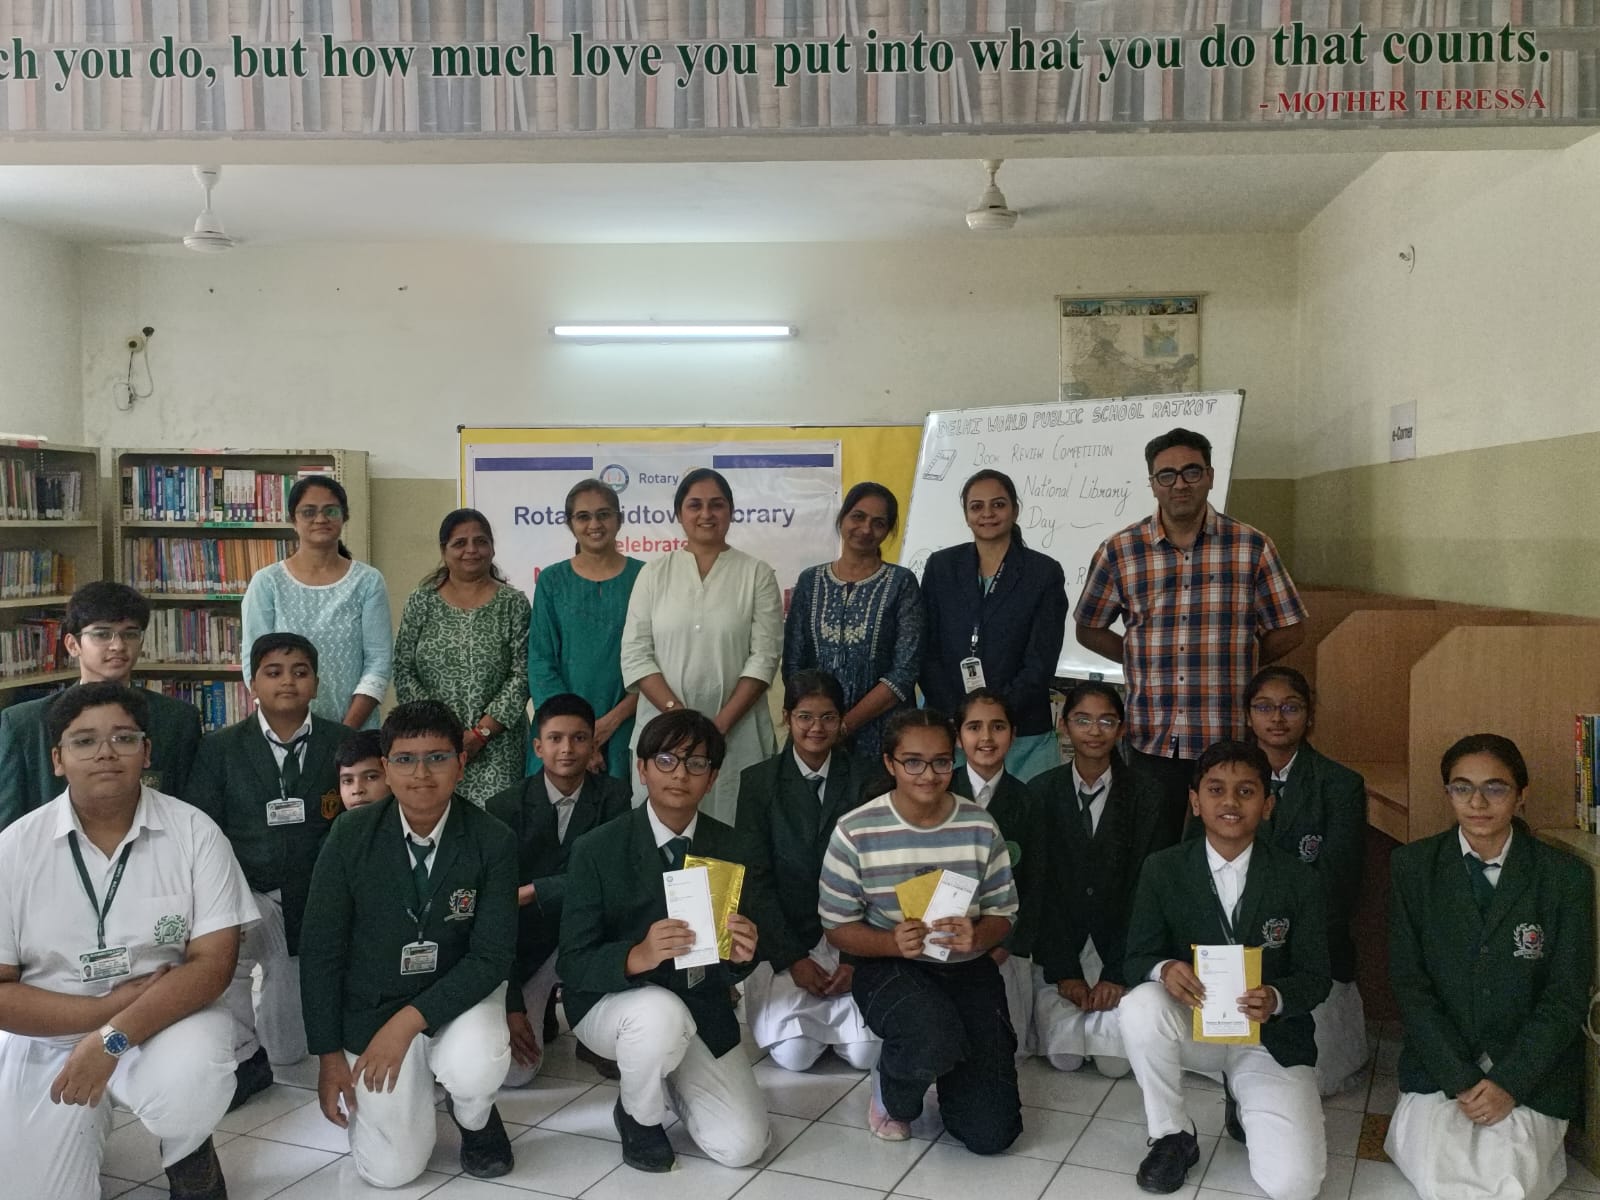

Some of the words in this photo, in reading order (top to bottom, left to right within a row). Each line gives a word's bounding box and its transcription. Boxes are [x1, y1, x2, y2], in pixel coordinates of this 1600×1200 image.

[54, 48, 132, 91] you
[149, 36, 217, 87] do,
[233, 35, 308, 78] but
[323, 34, 414, 78] how
[432, 34, 556, 77] much
[572, 33, 662, 76] love
[677, 43, 757, 88] you
[774, 35, 851, 87] put
[866, 29, 954, 73] into
[970, 27, 1085, 72] what
[1098, 36, 1181, 82] you
[1200, 24, 1256, 68] do
[1273, 22, 1368, 66] that
[1383, 21, 1550, 65] counts.
[1276, 90, 1407, 114] MOTHER
[1415, 88, 1546, 111] TERESSA
[1032, 407, 1085, 429] PUBLIC
[1091, 402, 1145, 424] SCHOOL
[1151, 399, 1217, 419] RAJKOT
[639, 472, 679, 485] Rotary
[1023, 474, 1072, 498] National
[514, 506, 567, 525] Rota
